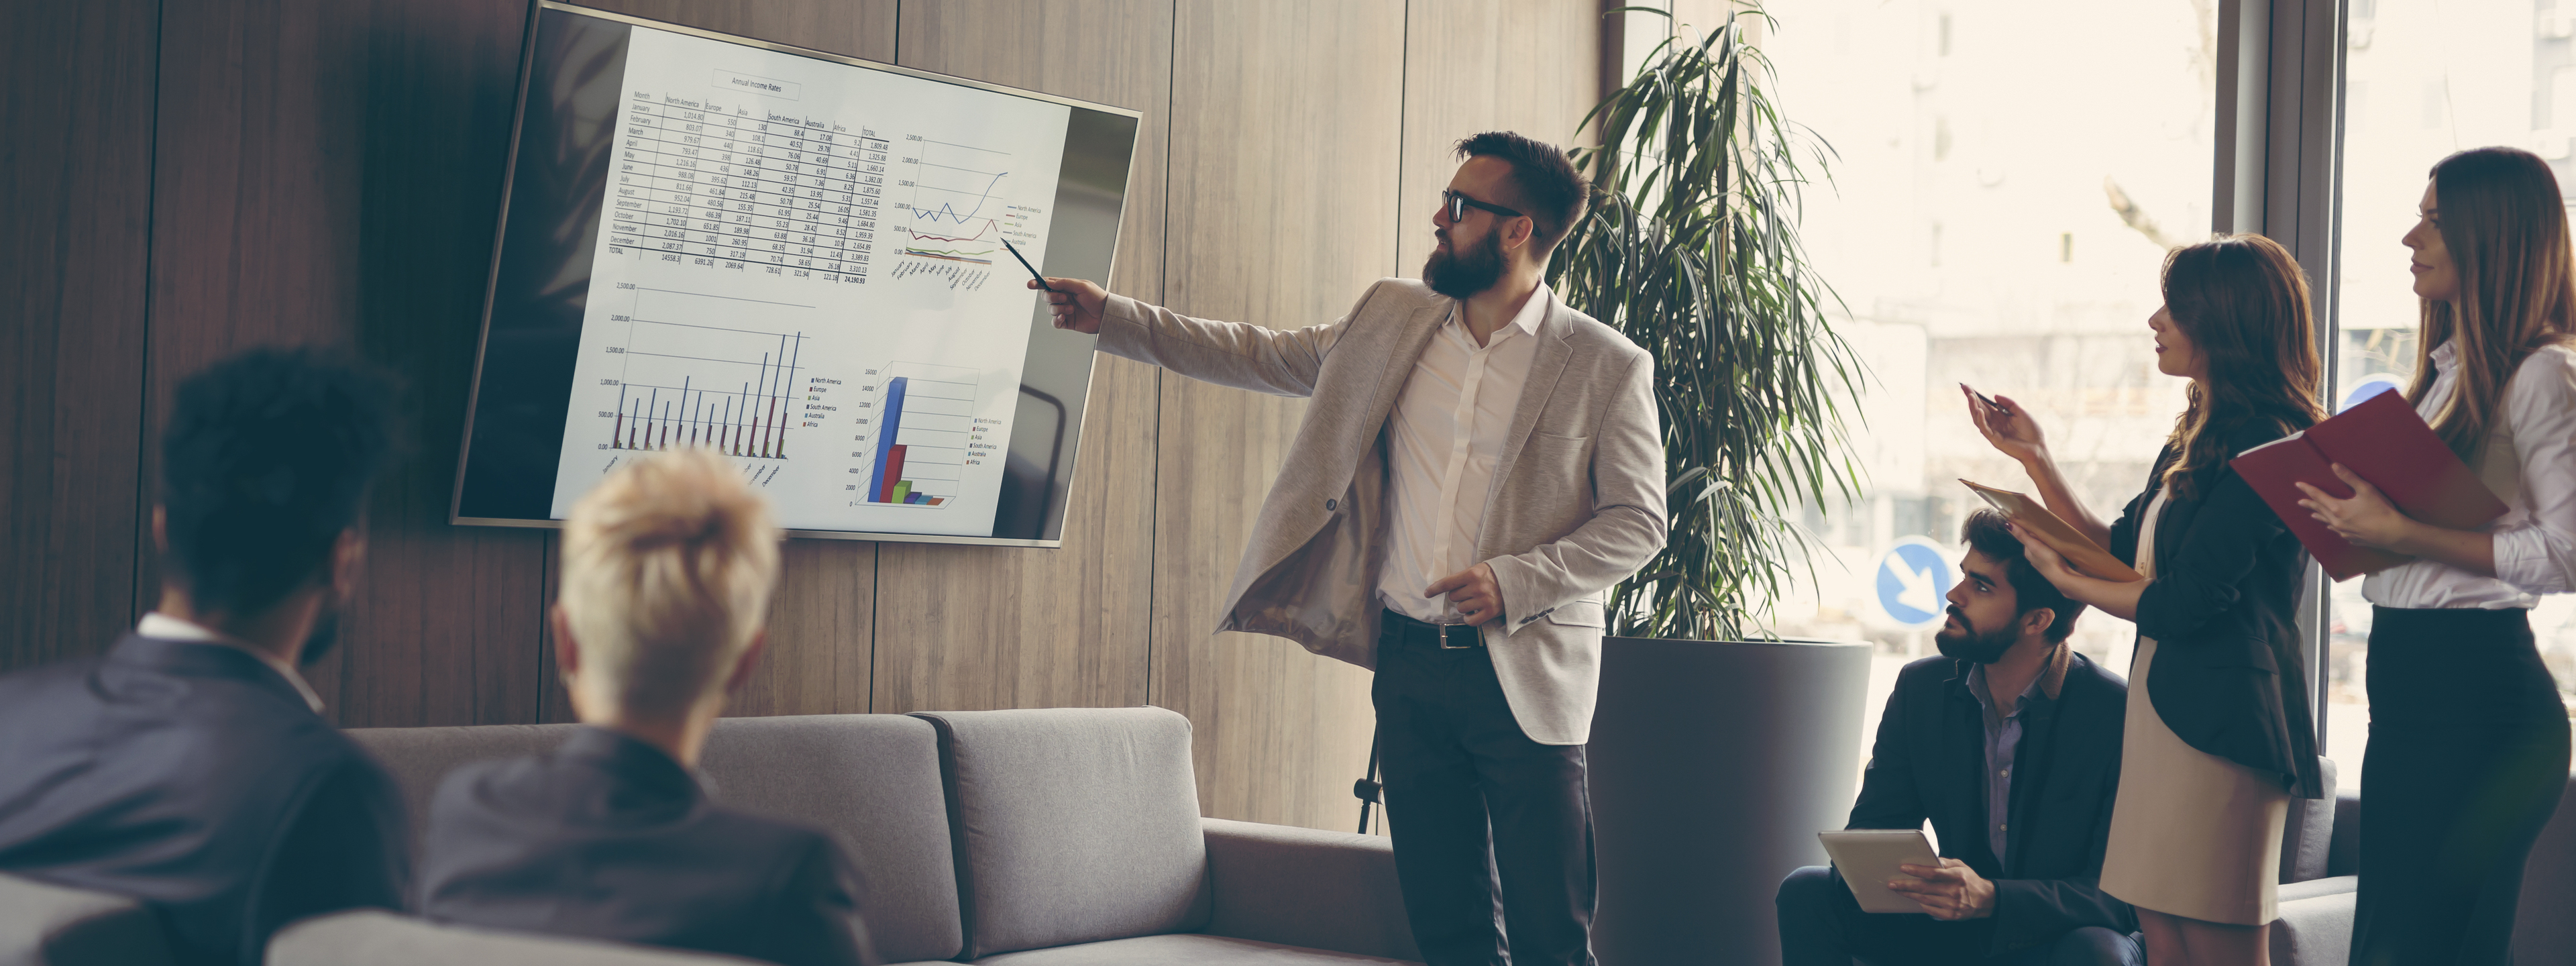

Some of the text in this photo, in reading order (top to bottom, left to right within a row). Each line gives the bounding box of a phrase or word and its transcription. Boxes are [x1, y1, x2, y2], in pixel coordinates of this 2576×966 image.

[731, 77, 782, 93] Annual Income Rates
[632, 103, 650, 113] January
[684, 111, 704, 121] 1,014.80
[727, 118, 737, 126] 550
[820, 133, 833, 142] 17.08
[870, 142, 889, 151] 1,809.48
[634, 91, 650, 100] Month
[665, 96, 680, 105] North
[680, 99, 700, 108] America
[706, 103, 722, 112] Europe
[739, 108, 748, 116] Asia
[767, 113, 782, 122] South
[782, 116, 800, 125] America
[805, 119, 824, 129] Australia
[863, 129, 875, 137] TOTAL
[628, 127, 643, 136] March
[684, 136, 700, 144] 979.67
[723, 142, 733, 150] 440
[747, 146, 763, 154] 118.61
[788, 152, 800, 160] 76.06
[815, 156, 828, 164] 40.69
[867, 164, 885, 173] 1,660.14
[630, 115, 651, 125] February
[686, 123, 702, 132] 803.07
[751, 134, 765, 143] 108.1
[789, 140, 802, 148] 40.52
[817, 145, 830, 153] 29.78
[869, 153, 887, 162] 1,325.88
[906, 134, 923, 142] 2,500.00
[624, 151, 635, 160] May
[676, 159, 696, 168] 1,216.16
[743, 169, 759, 177] 148.26
[784, 174, 796, 182] 59.57
[814, 179, 824, 187] 7.36
[843, 183, 853, 191] 8.25
[863, 186, 881, 196] 1,875.60
[626, 139, 638, 148] April
[682, 148, 698, 156] 793.47
[745, 157, 761, 166] 126.48
[786, 163, 798, 171] 50.78
[845, 172, 855, 180] 6.36
[865, 175, 883, 184] 1,382.00
[902, 156, 919, 165] 2,000.00
[620, 175, 877, 217] July 811.66 461.84 215.48 50.78 25.54 16.05 1,581.35
[622, 163, 633, 171] June
[678, 171, 694, 180] 988.08
[711, 176, 727, 184] 395.62
[741, 180, 757, 189] 112.13
[782, 186, 794, 194] 42.35
[810, 190, 822, 198] 13.95
[861, 198, 879, 207] 1,557.44
[898, 179, 915, 188] 1,500.00
[616, 199, 642, 209] September
[668, 206, 688, 215] 1,193.72
[705, 211, 721, 219] 486.39
[735, 215, 751, 223] 187.11
[804, 224, 816, 232] 28.42
[855, 231, 873, 239] 1,959.39
[618, 187, 875, 229] August 952.04 480.56 155.35 61.95 25.44 9.46 1,684.80
[894, 202, 911, 210] 1,000.00
[612, 223, 869, 262] November 2,016.16 1001 260.95 68.35 31.94 11.43 3,389.83
[614, 211, 634, 220] October
[666, 218, 686, 227] 1,702.10
[703, 222, 719, 231] 651.85
[734, 226, 749, 235] 189.98
[773, 231, 787, 239] 63.88
[802, 235, 815, 244] 36.18
[853, 242, 871, 251] 2,654.89
[608, 246, 865, 284] TOTAL 14558.3 6391.26 2069.64 728.61 321.94 121.18 24,190.93
[610, 235, 867, 274] December 2,087.37 750 317.19 70.74 58.65 26.18 3,310.13
[616, 282, 636, 291] 2,500.00
[610, 314, 631, 323] 2,000.00
[605, 346, 625, 355] 1,500.00
[600, 378, 620, 387] 1,000.00
[813, 386, 827, 394] Europe
[598, 411, 614, 419] 500.00
[761, 465, 781, 487] December
